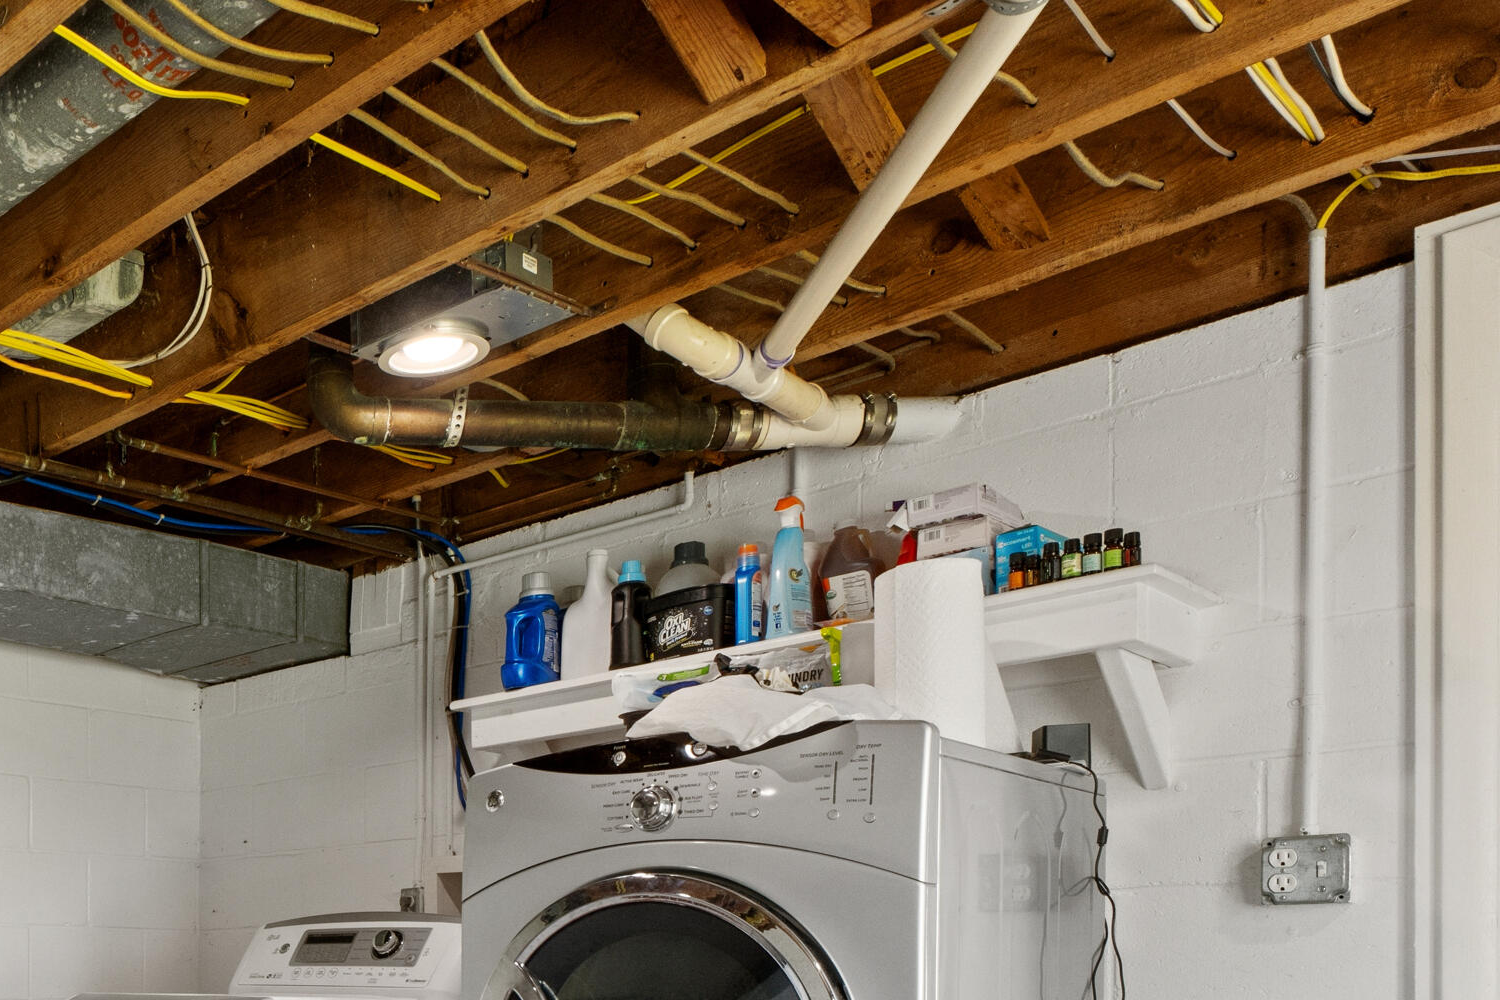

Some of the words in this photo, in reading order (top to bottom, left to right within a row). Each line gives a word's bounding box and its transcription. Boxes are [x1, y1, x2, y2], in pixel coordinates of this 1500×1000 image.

[664, 613, 684, 630] OXI
[659, 618, 691, 646] CLEAN
[788, 668, 824, 683] UNDRY
